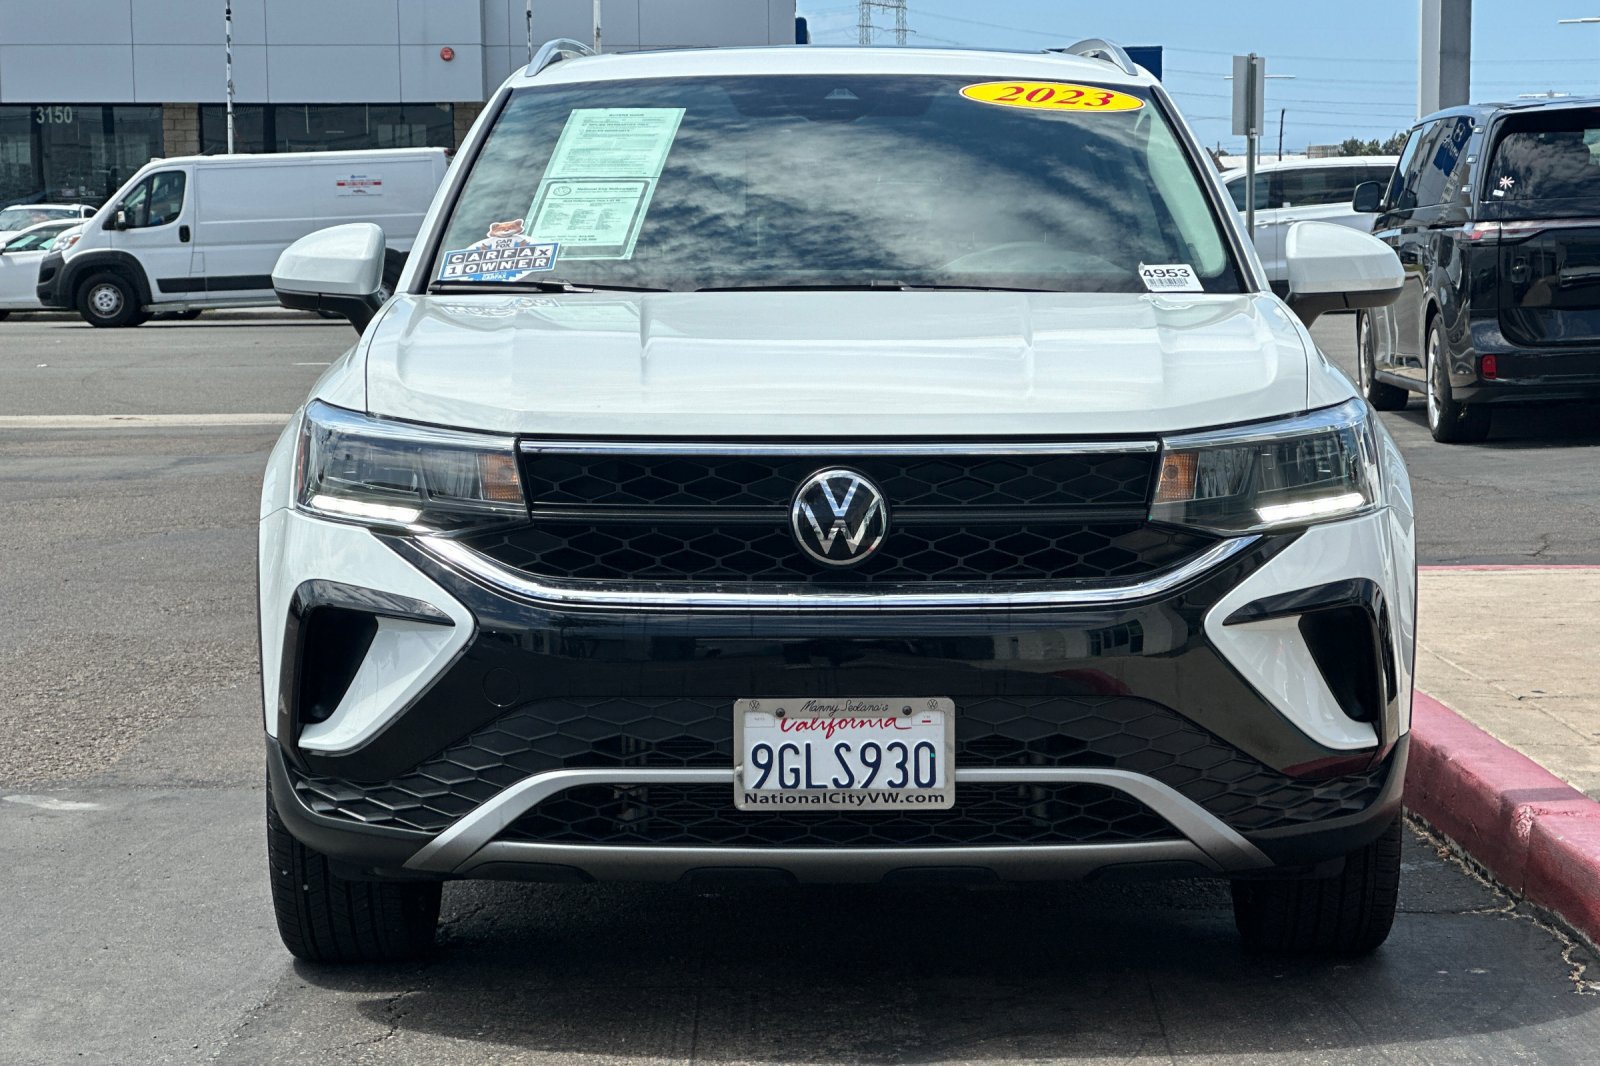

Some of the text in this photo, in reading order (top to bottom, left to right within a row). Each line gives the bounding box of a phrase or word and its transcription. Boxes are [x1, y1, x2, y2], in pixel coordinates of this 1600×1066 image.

[993, 86, 1115, 107] 2023
[36, 105, 73, 124] 3150
[451, 248, 550, 263] CARFAX
[448, 258, 547, 275] 1 OWNER
[1143, 268, 1190, 278] 4953
[800, 699, 840, 717] Manny
[780, 716, 912, 739] California
[751, 741, 937, 789] 9GLS930
[744, 791, 945, 806] NationalCityVW.com
